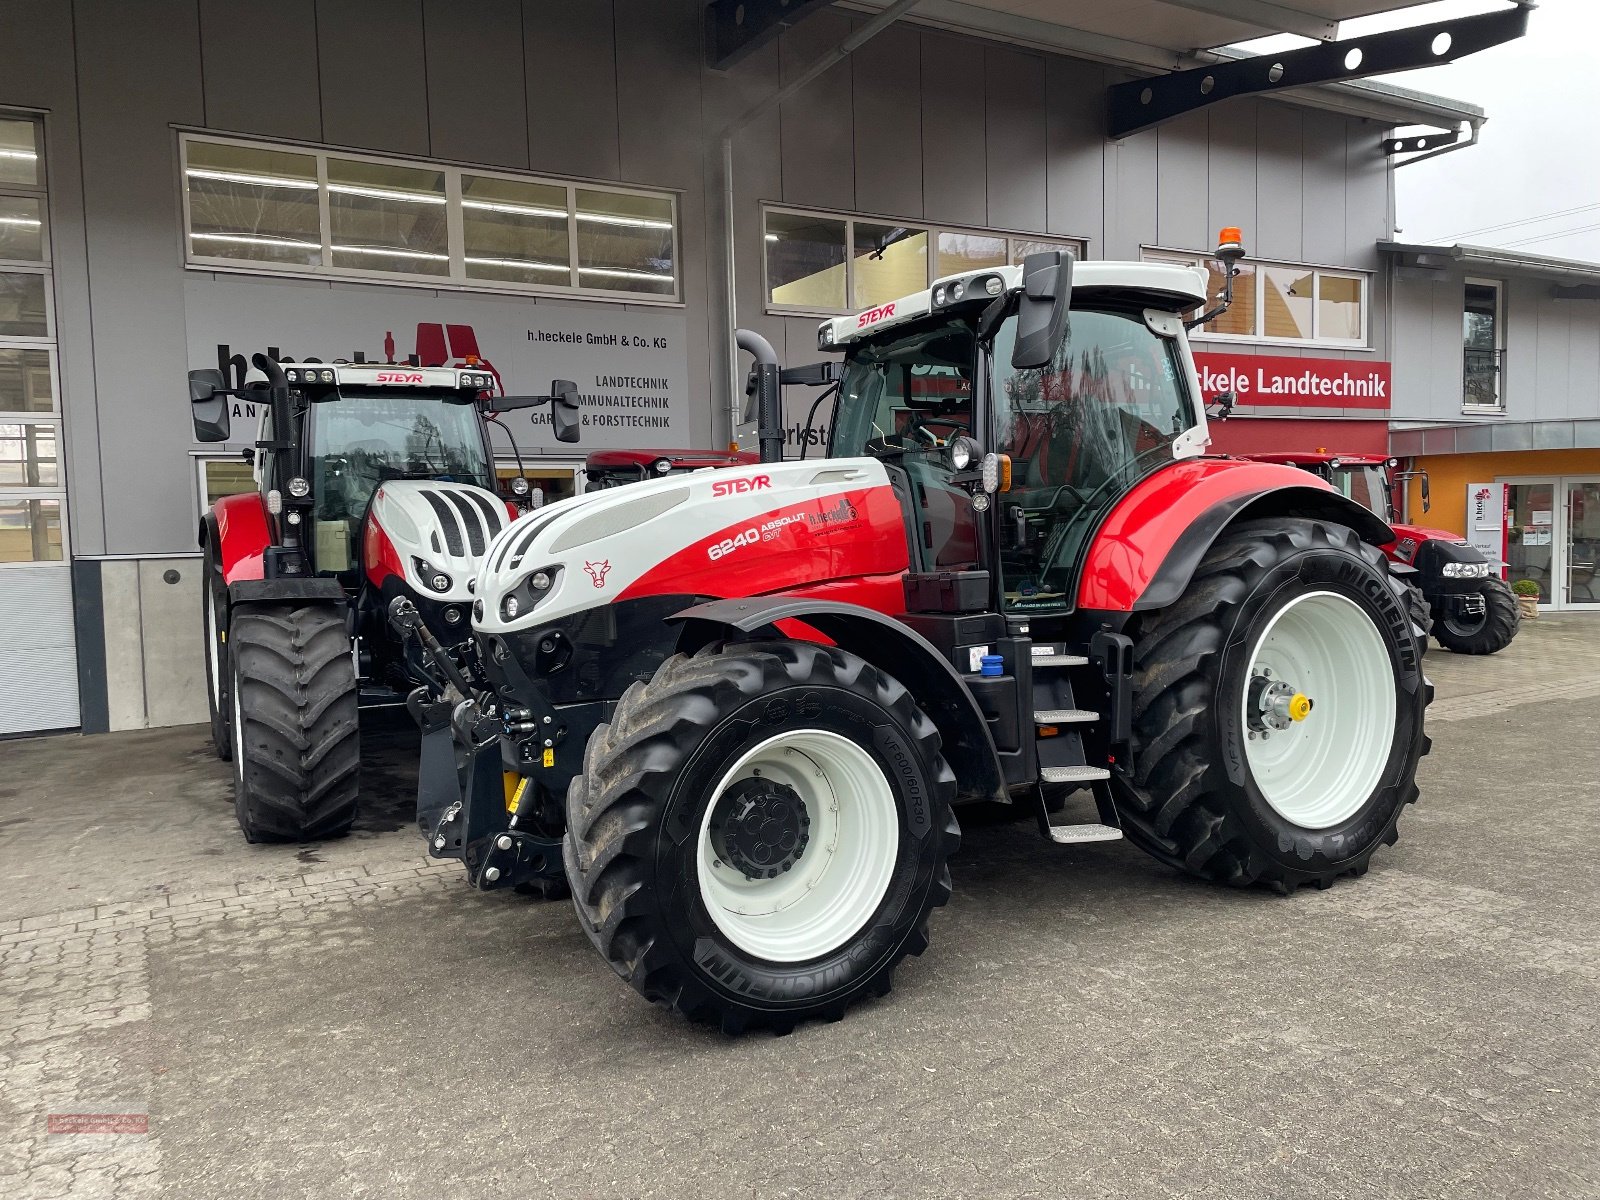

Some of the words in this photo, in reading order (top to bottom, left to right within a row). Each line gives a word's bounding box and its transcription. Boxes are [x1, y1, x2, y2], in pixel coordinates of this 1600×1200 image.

[858, 303, 896, 328] STEYR
[527, 329, 582, 344] h.heckele
[586, 332, 617, 346] GmbH
[621, 335, 630, 347] &
[633, 336, 650, 348] Co.
[653, 337, 667, 349] KG
[376, 372, 423, 384] STEYR
[595, 375, 669, 390] LANDTECHNIK
[1257, 368, 1386, 398] Landtechnik
[577, 394, 670, 409] MMUNALTECHNIK
[581, 414, 590, 426] &
[592, 414, 670, 428] FORSTTECHNIK
[712, 474, 772, 498] STEYR
[707, 527, 760, 561] 6240
[761, 512, 806, 532] ABSOLUT
[763, 528, 781, 542] CVT
[1338, 561, 1416, 671] MICHELIN
[702, 953, 853, 999] MICHELIN
